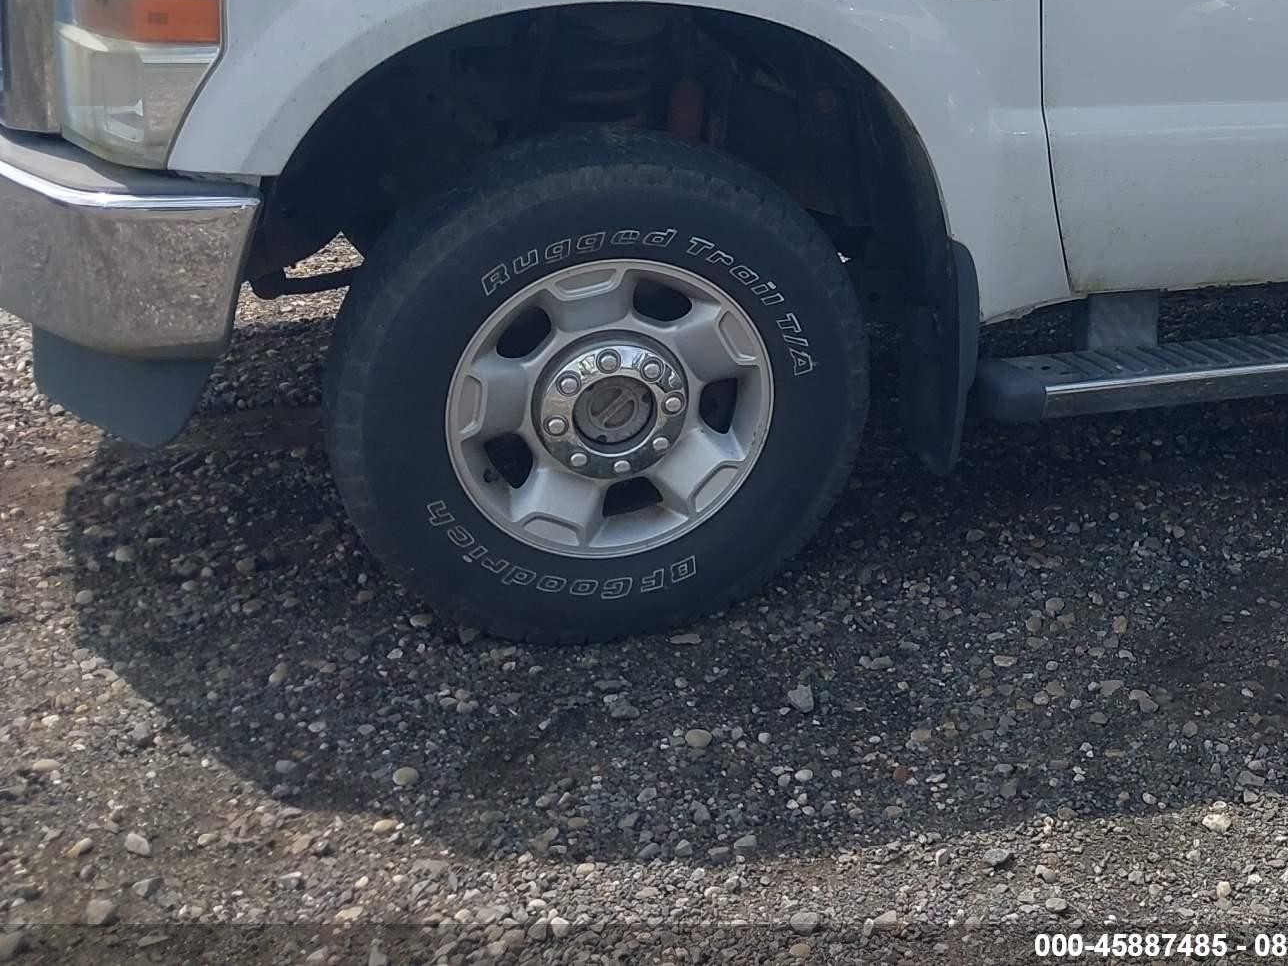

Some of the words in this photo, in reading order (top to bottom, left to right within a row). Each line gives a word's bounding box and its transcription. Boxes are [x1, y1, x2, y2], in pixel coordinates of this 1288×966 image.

[481, 229, 678, 296] Rugged
[686, 237, 784, 306] Trail
[777, 313, 814, 376] T/A
[427, 500, 697, 599] BFGoodrich
